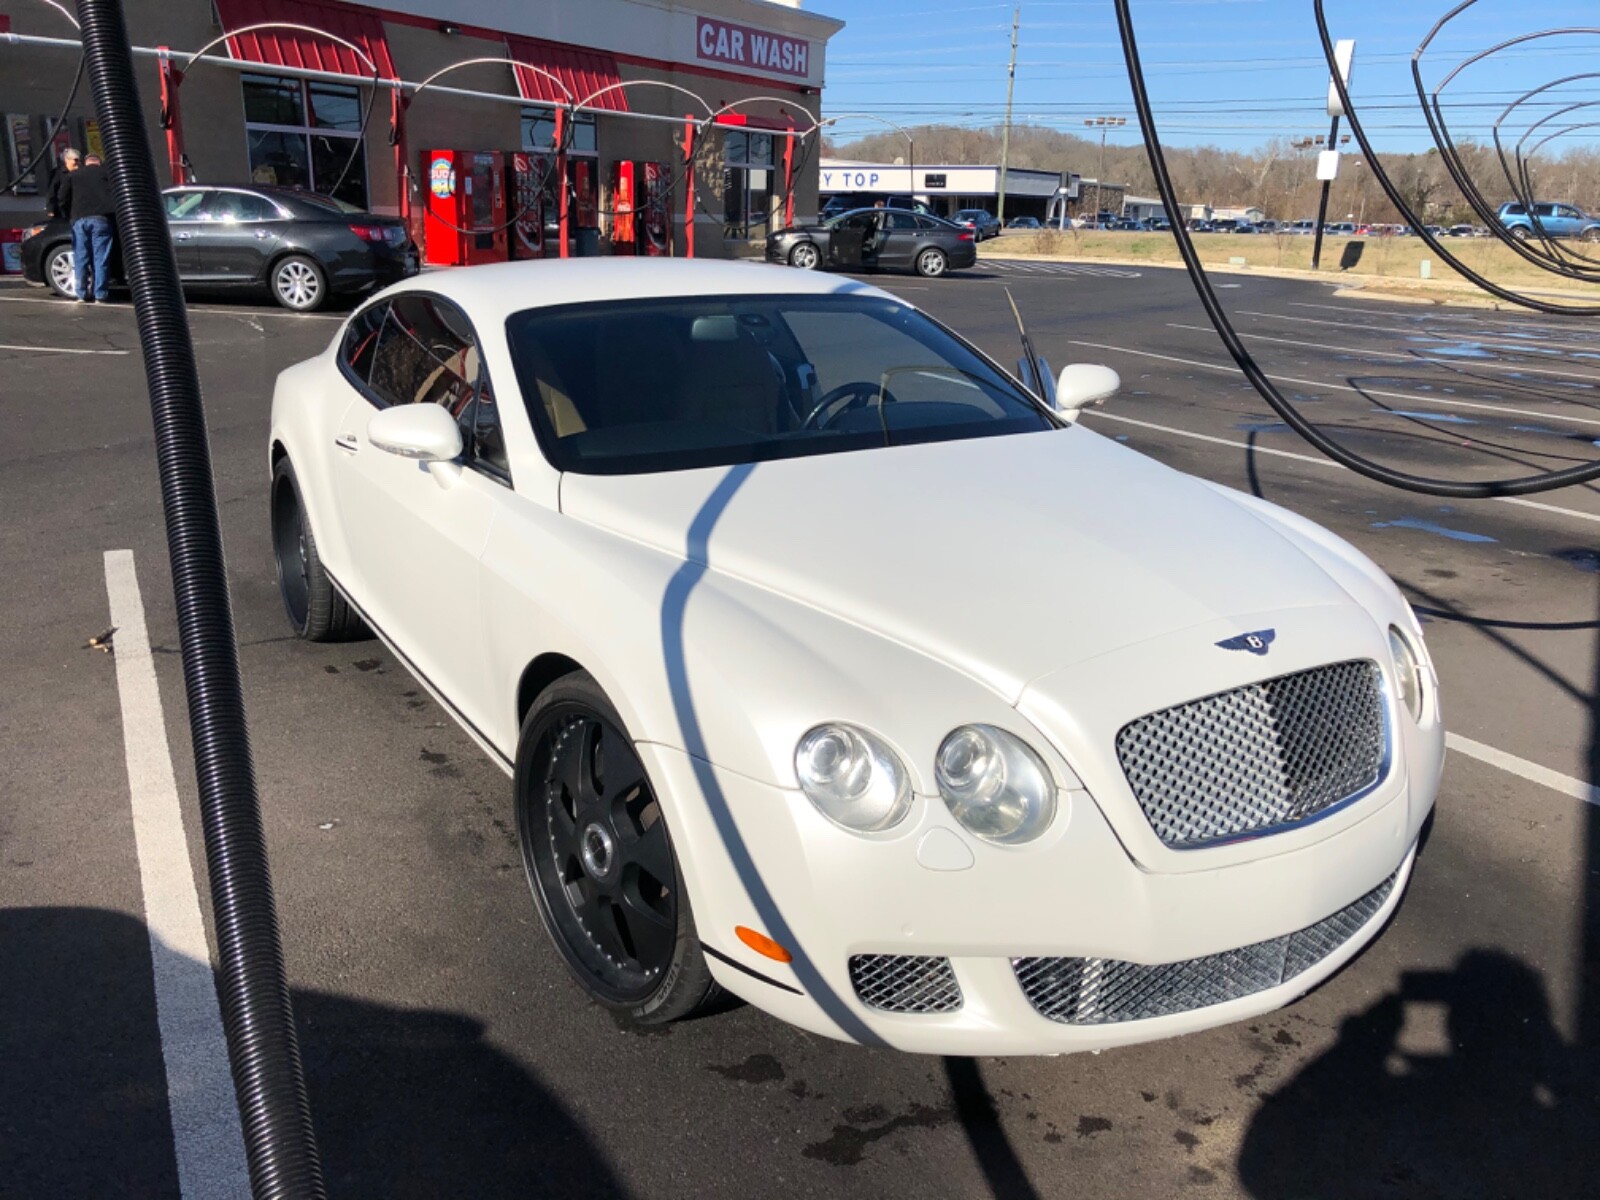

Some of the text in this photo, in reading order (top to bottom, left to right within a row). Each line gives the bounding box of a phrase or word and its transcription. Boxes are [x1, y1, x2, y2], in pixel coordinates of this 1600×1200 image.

[700, 23, 807, 73] CAR WASH
[842, 172, 879, 187] TOP
